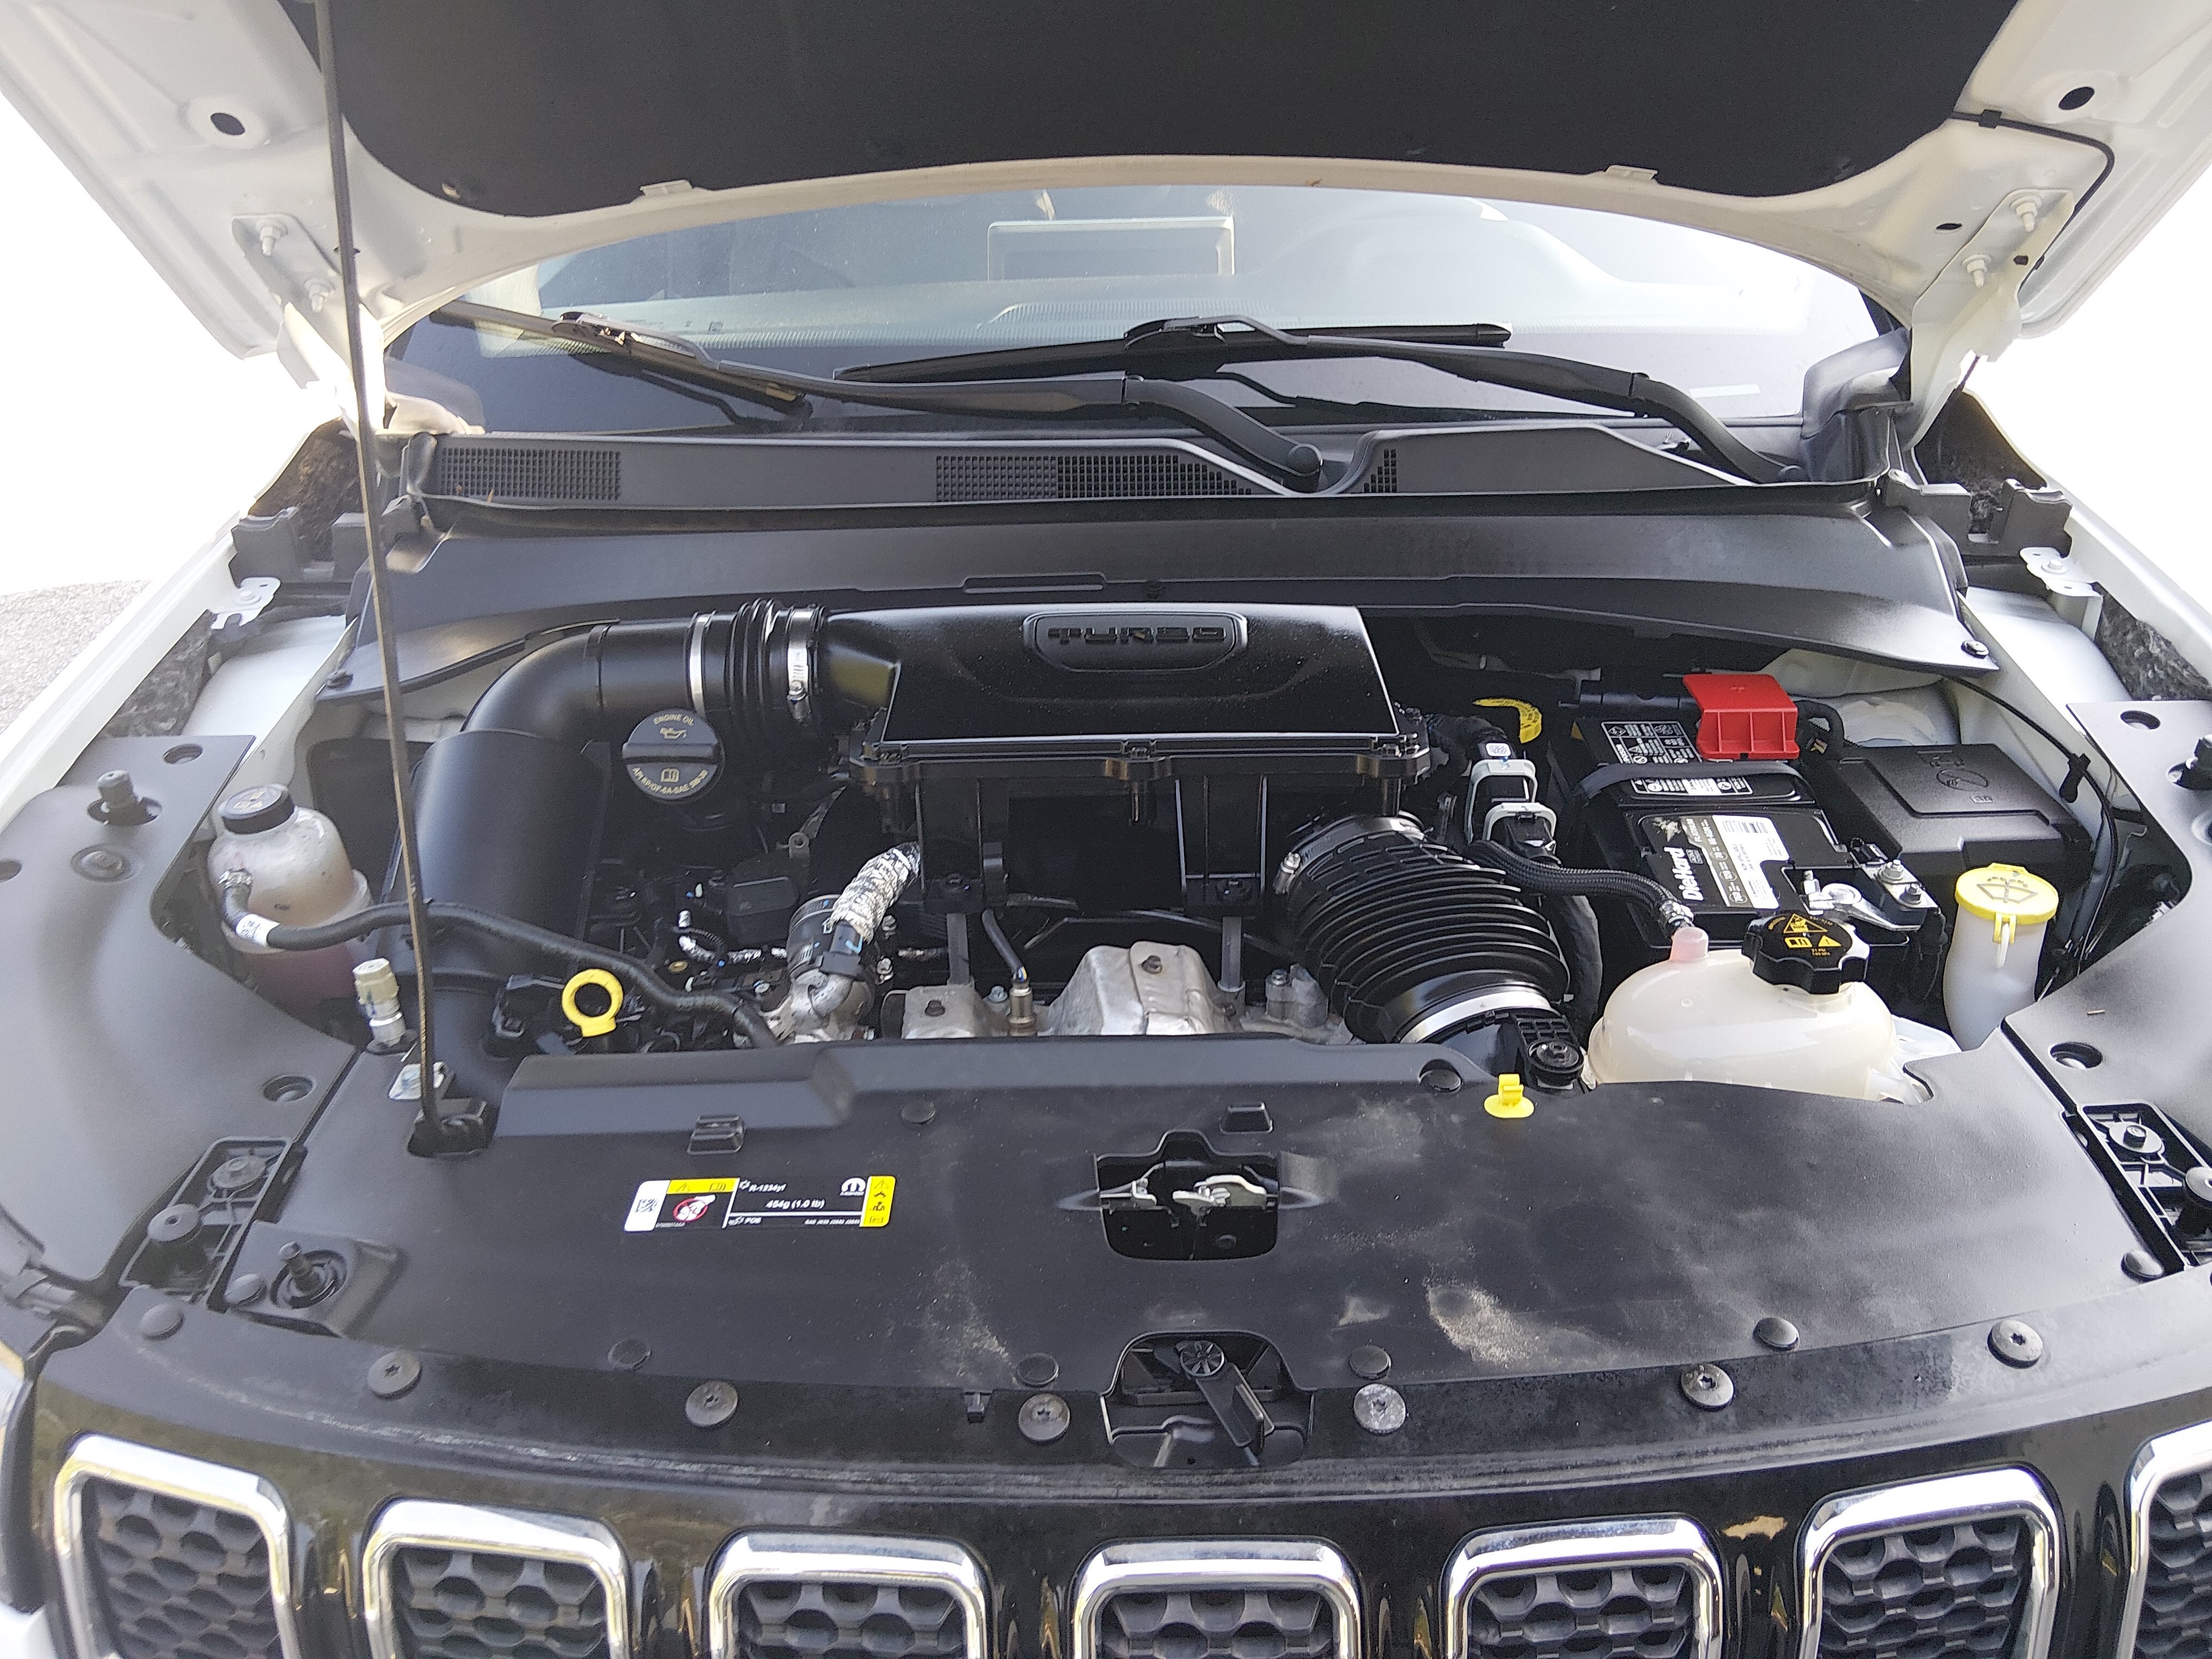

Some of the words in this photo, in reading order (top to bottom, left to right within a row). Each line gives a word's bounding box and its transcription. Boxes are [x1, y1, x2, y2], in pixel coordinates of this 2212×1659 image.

[1047, 627, 1227, 644] TURBO
[653, 713, 682, 725] ENGINE
[683, 716, 694, 726] OIL
[1663, 846, 1703, 901] DieHard
